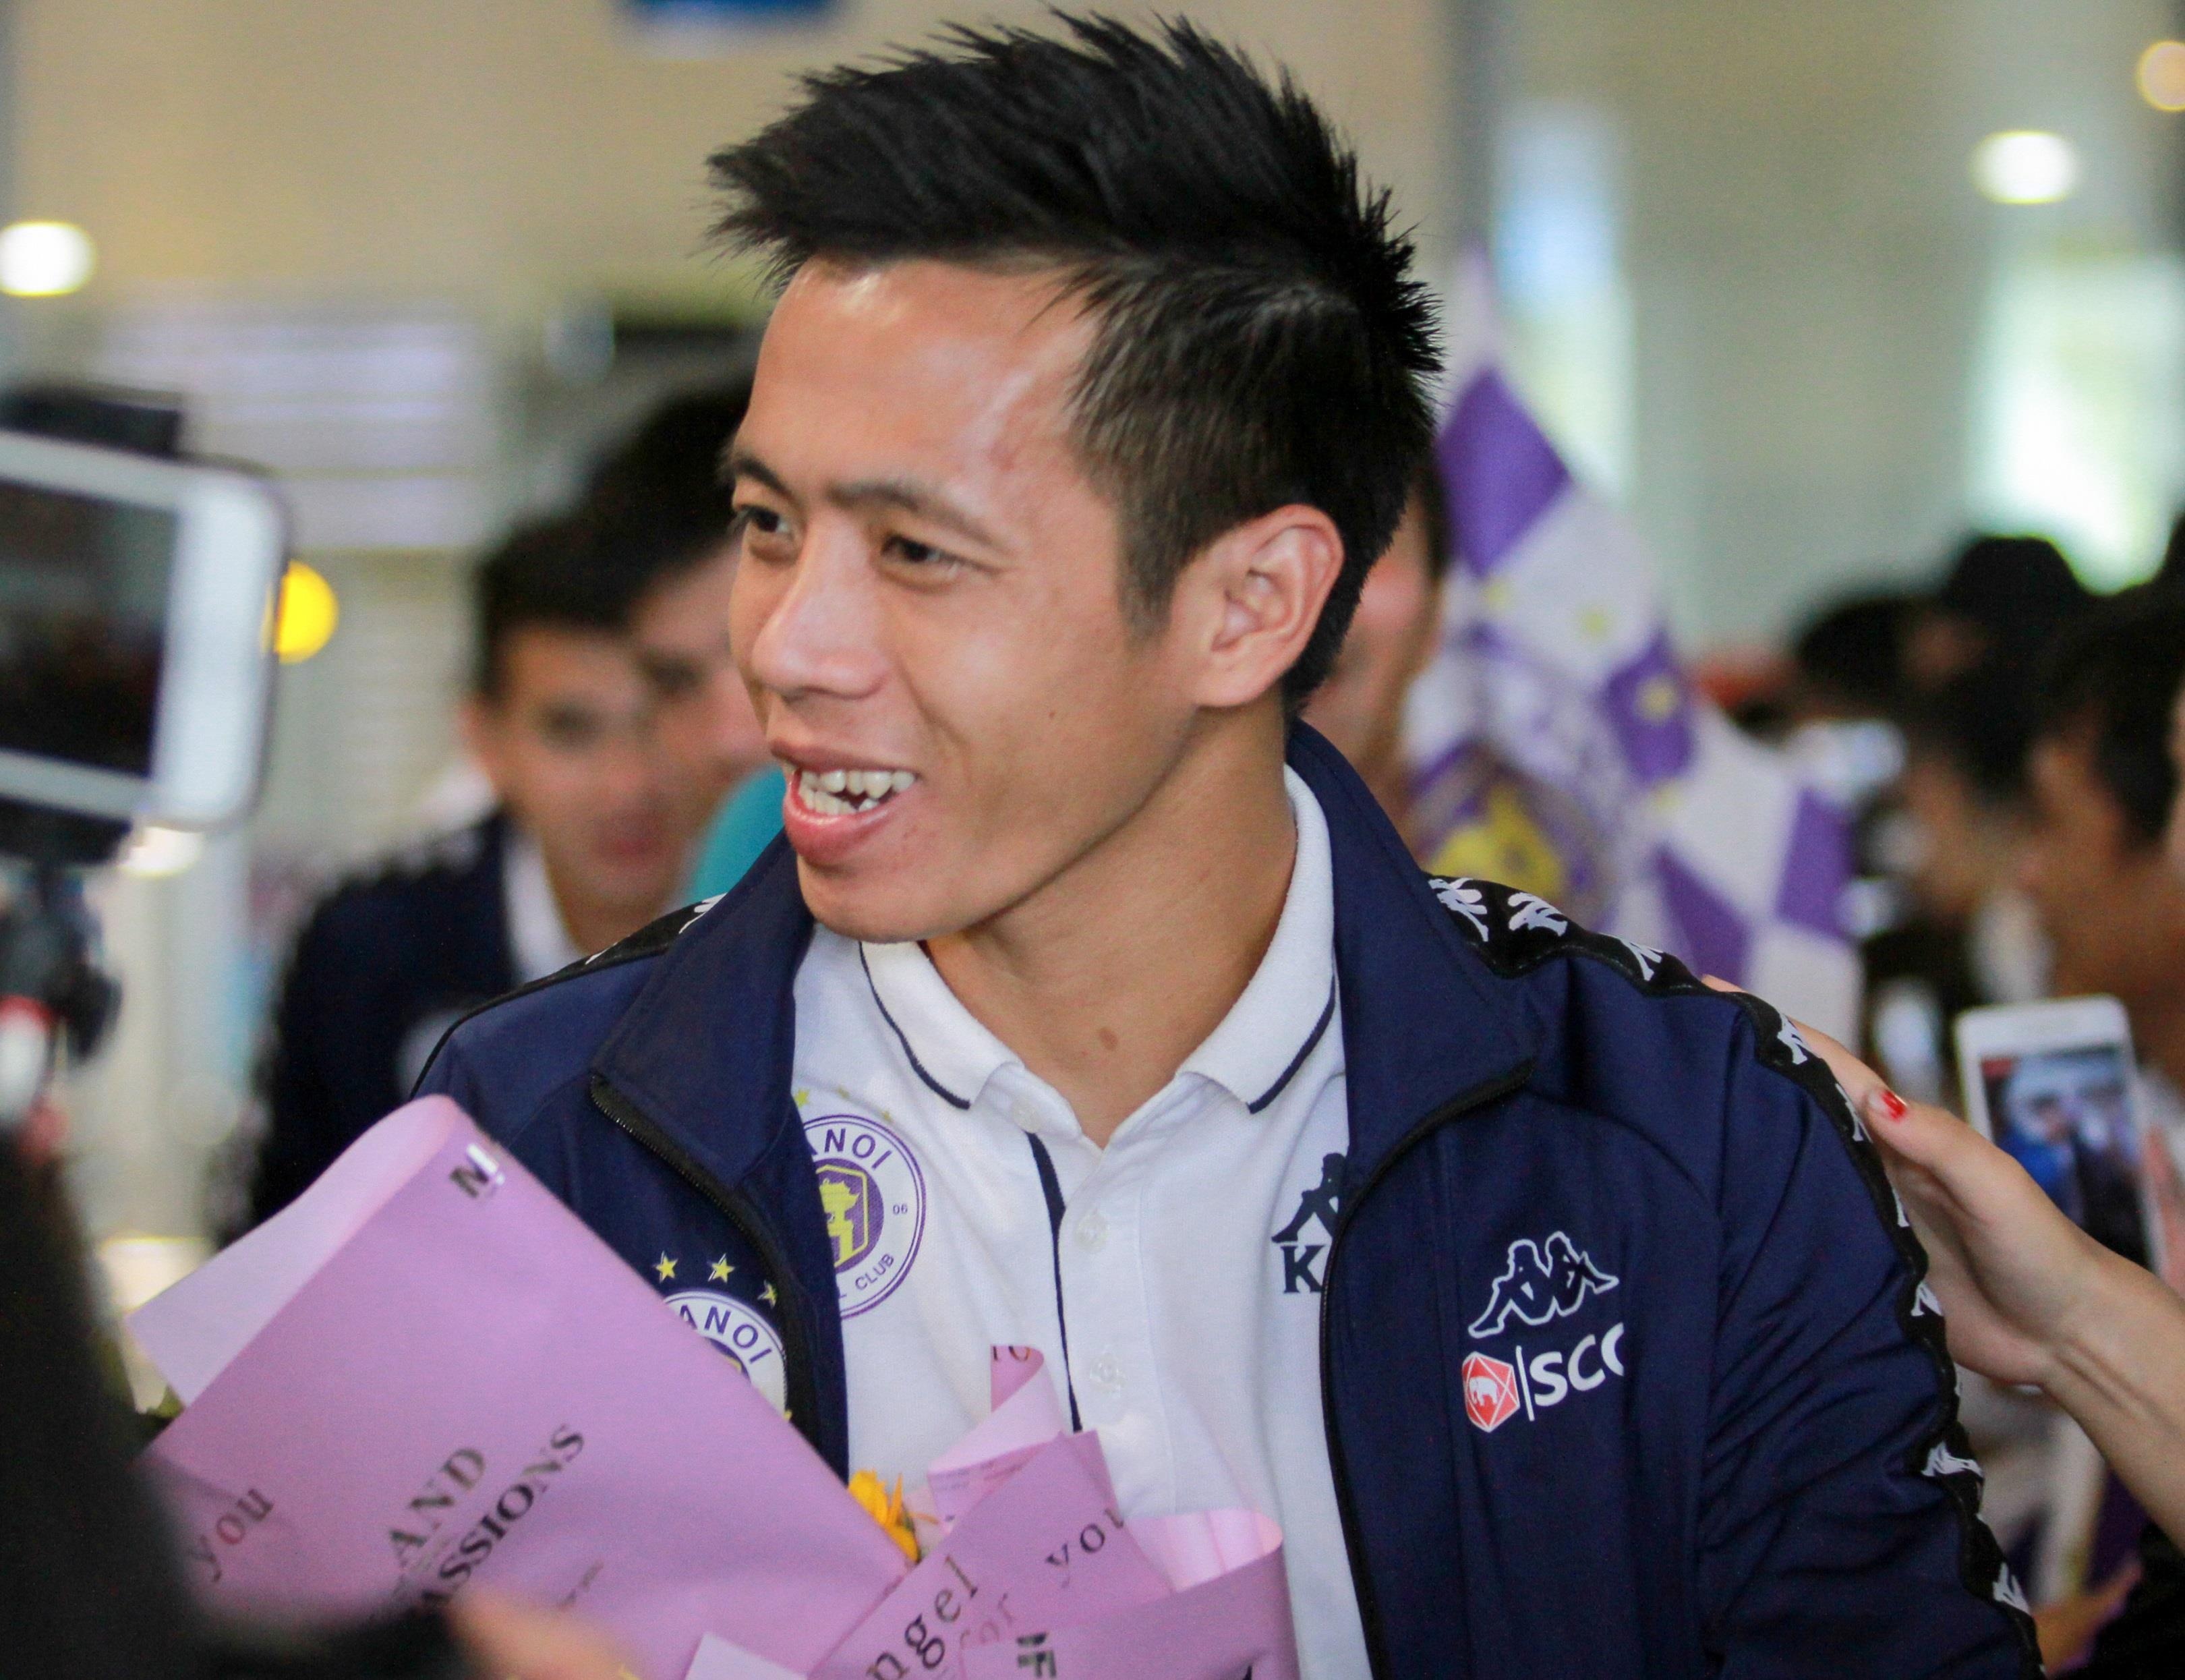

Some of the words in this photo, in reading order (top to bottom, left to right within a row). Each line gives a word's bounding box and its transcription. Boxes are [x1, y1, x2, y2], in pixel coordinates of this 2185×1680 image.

[812, 1128, 892, 1170] NOI
[854, 1253, 895, 1291] CLUB
[389, 1447, 486, 1570] AND
